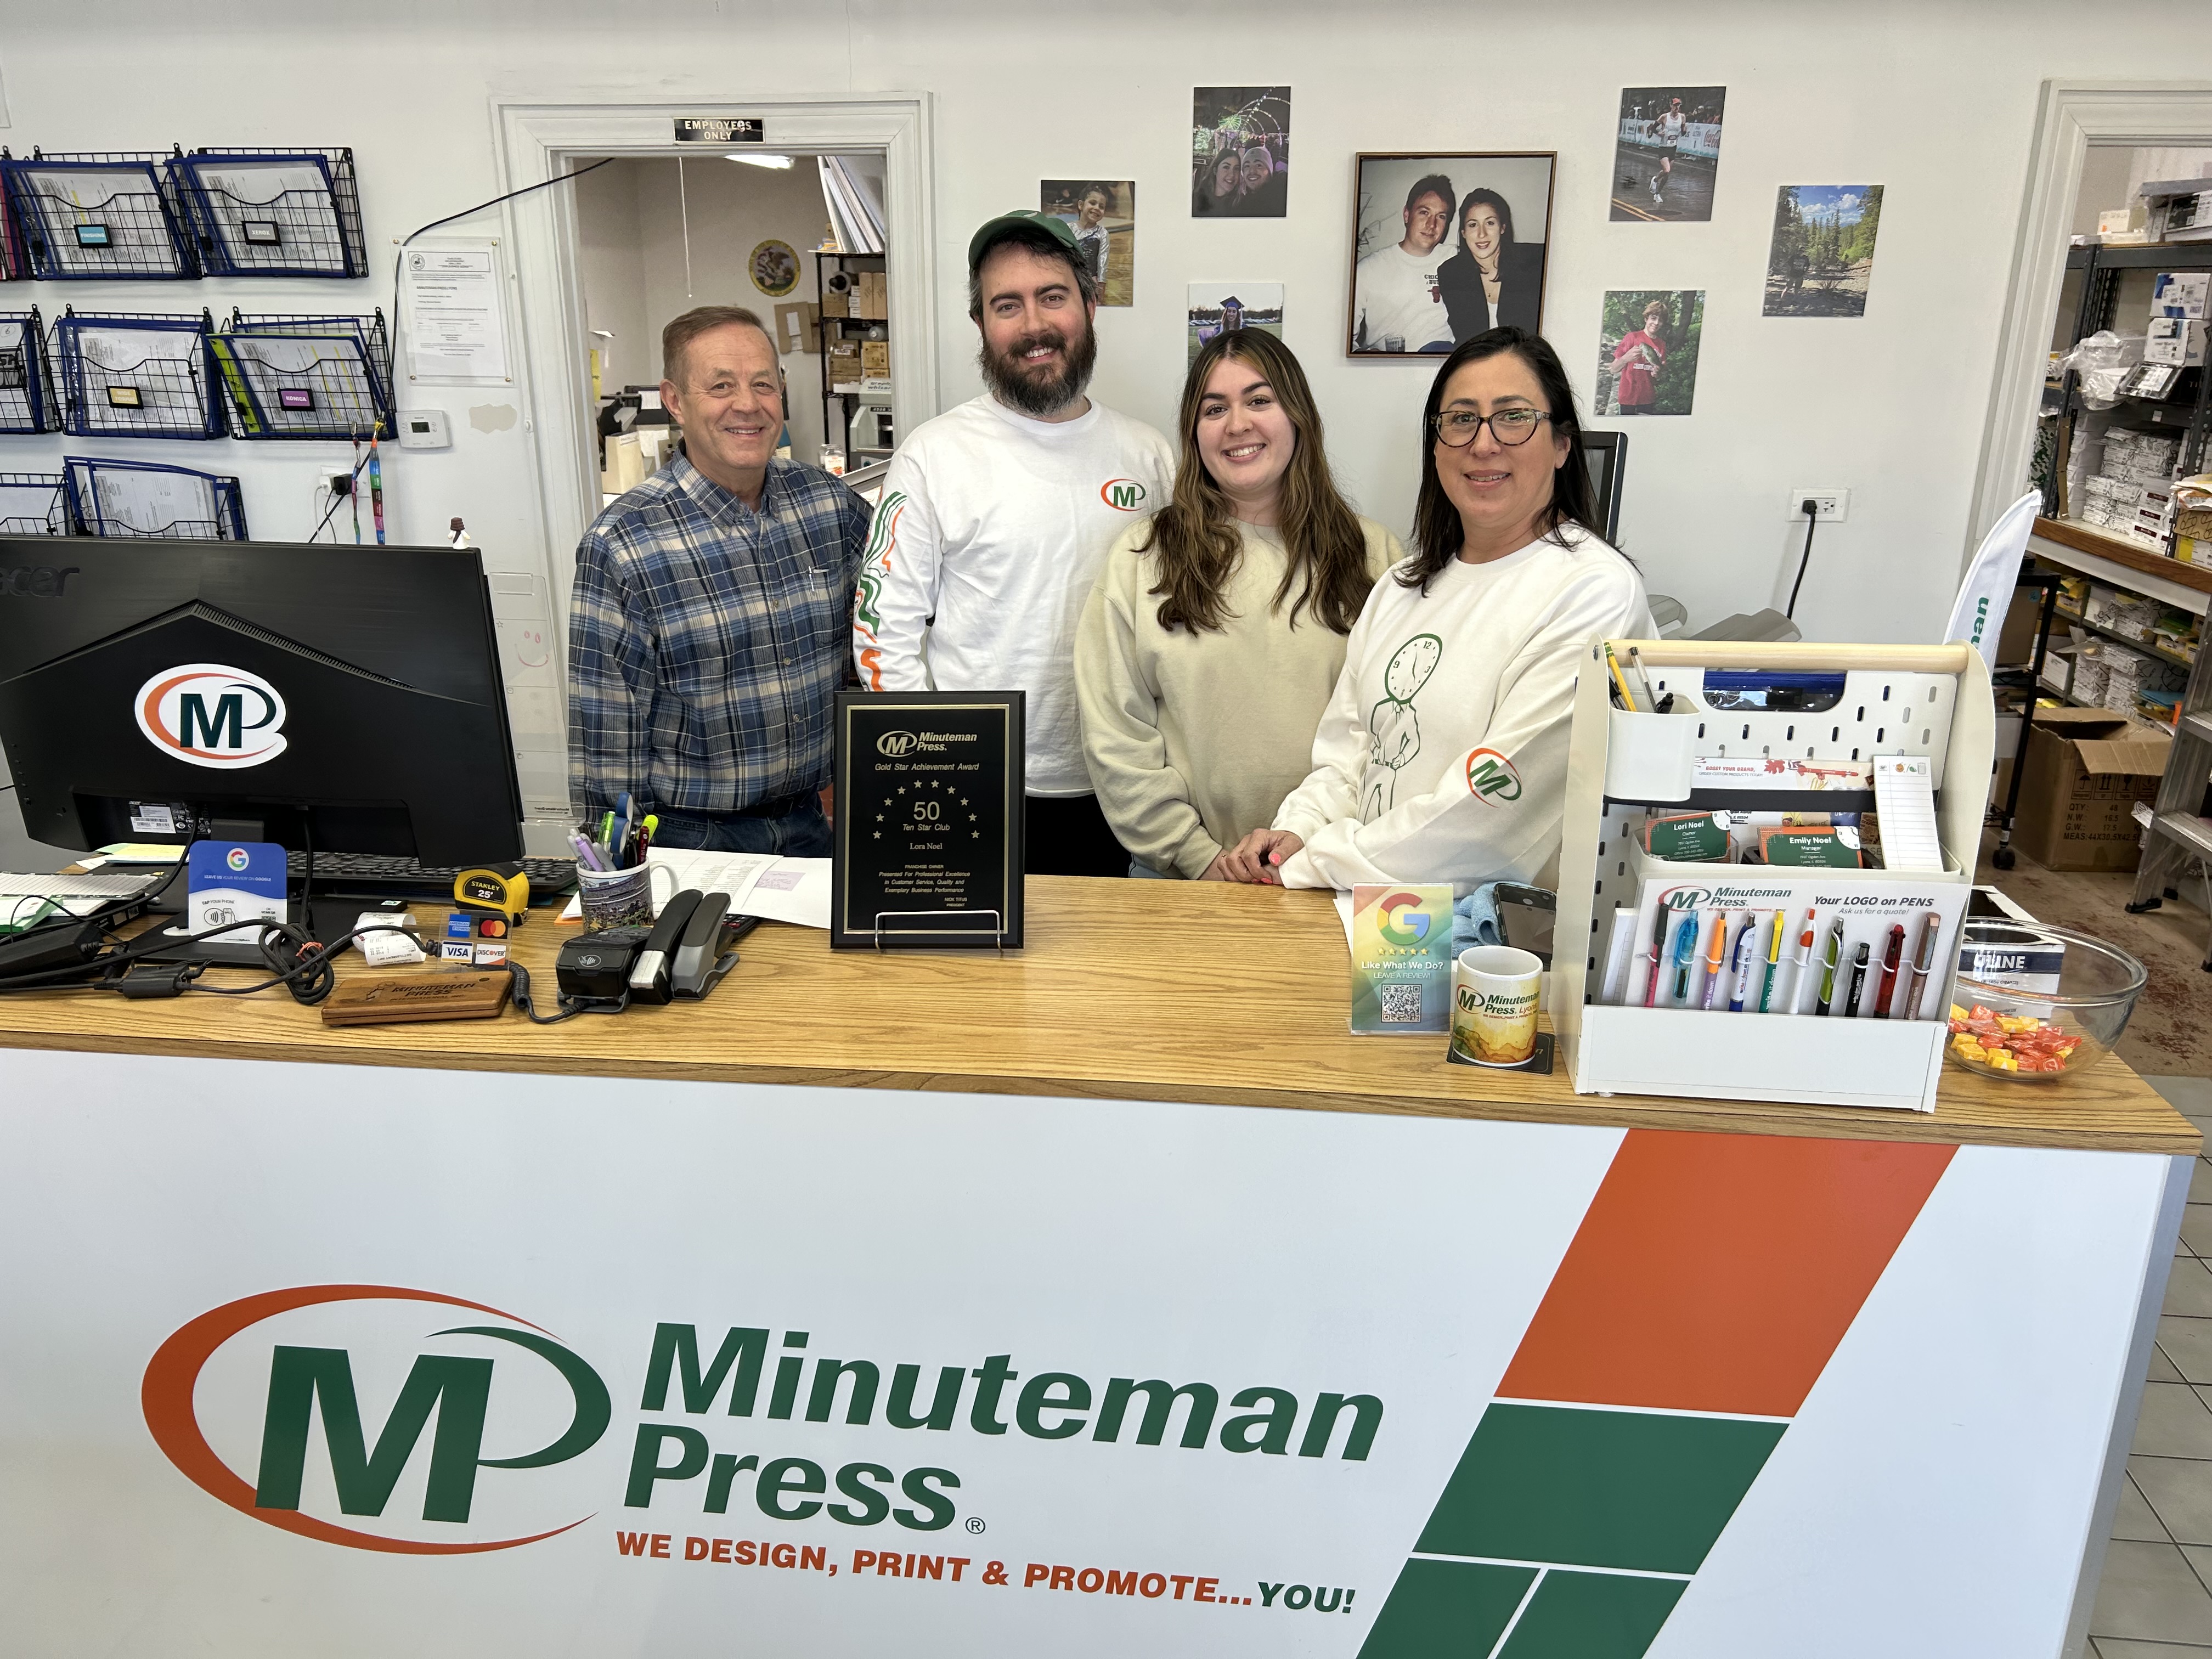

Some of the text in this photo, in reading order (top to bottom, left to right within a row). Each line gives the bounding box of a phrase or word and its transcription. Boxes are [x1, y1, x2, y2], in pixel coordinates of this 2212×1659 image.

[704, 131, 732, 140] ONLY
[1423, 641, 1432, 650] 12
[1392, 660, 1400, 669] 9
[1424, 665, 1431, 674] 3
[919, 732, 978, 741] Minuteman
[913, 802, 940, 821] 50
[1674, 820, 1704, 831] Lori Noel
[1789, 837, 1812, 845] Emily
[471, 881, 500, 891] STANLEY
[477, 889, 494, 899] 25'
[1714, 887, 1792, 897] Minuteman
[1814, 896, 1842, 905] Your
[1843, 896, 1878, 905] LOGO
[1899, 898, 1934, 906] PENS
[445, 947, 469, 957] VISA
[1383, 961, 1407, 969] What
[1408, 961, 1422, 969] We
[1425, 961, 1444, 969] Do?
[392, 983, 476, 992] MINUTEMAN
[640, 1322, 1384, 1462] Minuteman
[616, 1531, 672, 1559] WE
[684, 1537, 838, 1577] DESIGN,
[853, 1550, 971, 1582] PRINT
[981, 1560, 1008, 1586] &
